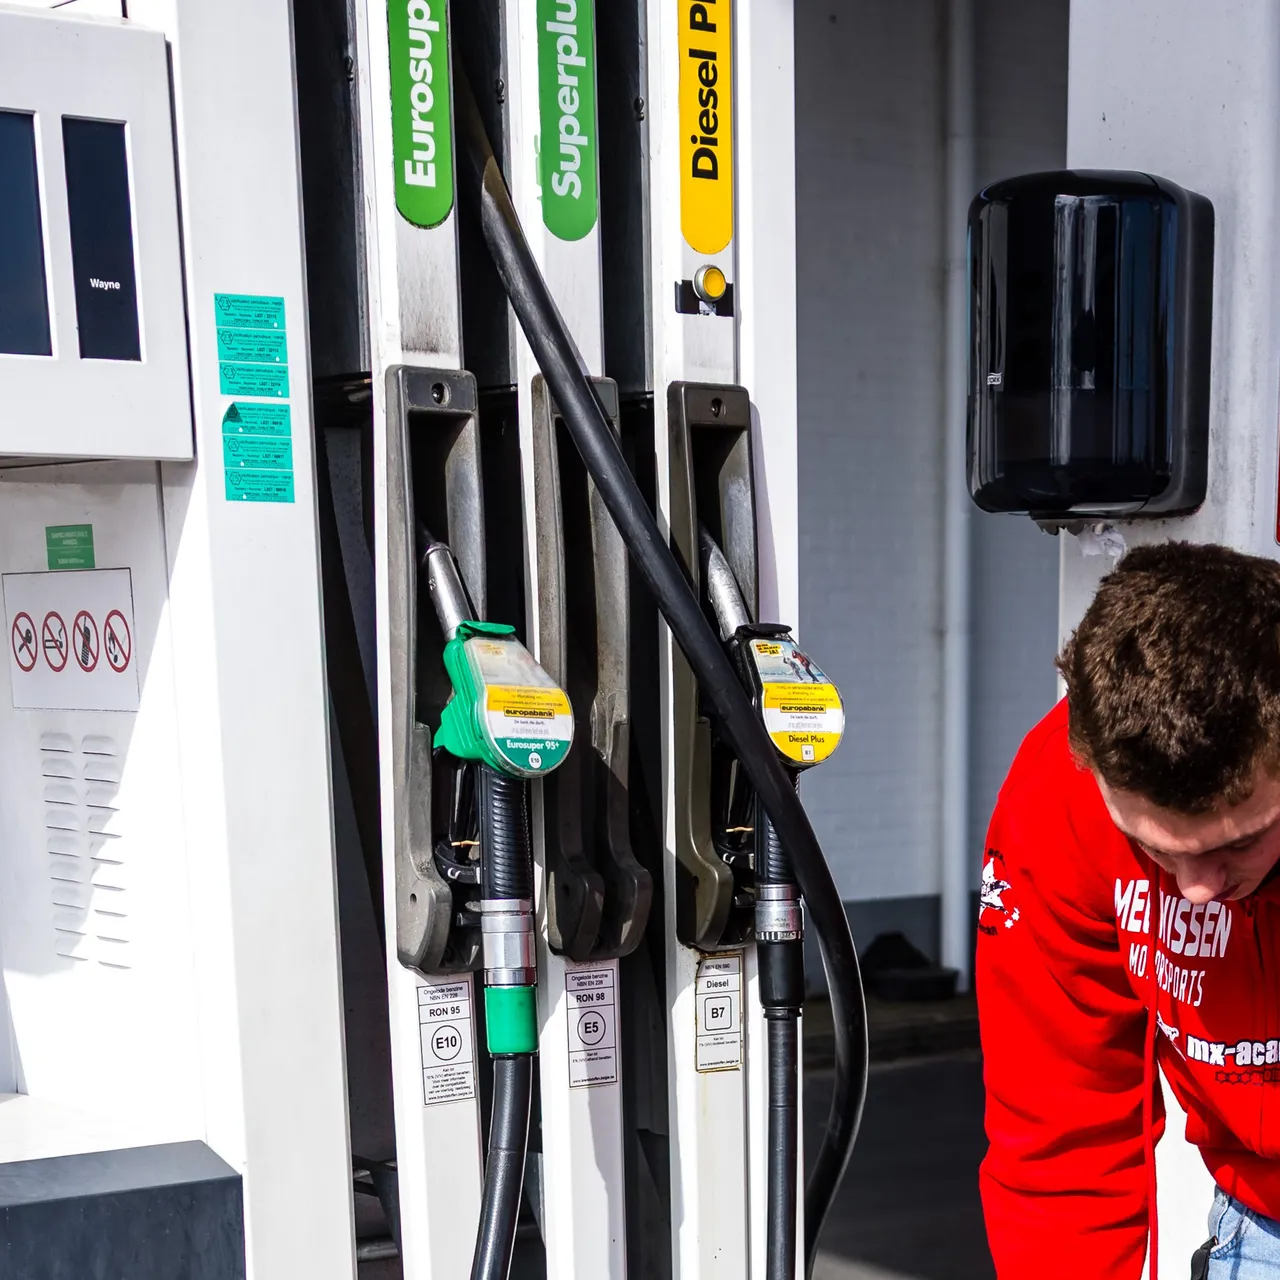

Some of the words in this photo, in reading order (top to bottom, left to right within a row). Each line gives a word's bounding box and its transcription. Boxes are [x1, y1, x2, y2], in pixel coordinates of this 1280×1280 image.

[688, 49, 719, 181] Diesel
[90, 278, 121, 291] Wayne
[505, 708, 553, 718] europabank
[781, 704, 825, 712] europabank
[788, 734, 809, 743] Diesel
[810, 735, 825, 744] Plus
[506, 740, 544, 751] Eurosuper
[1129, 943, 1206, 1007] MOORSPORTS
[706, 979, 729, 988] Diesel
[576, 993, 594, 1003] RON
[595, 992, 605, 1001] 98
[429, 1007, 448, 1017] RON
[451, 1006, 461, 1014] 95
[711, 1007, 725, 1018] B7
[584, 1021, 599, 1034] E5
[435, 1035, 457, 1049] E10
